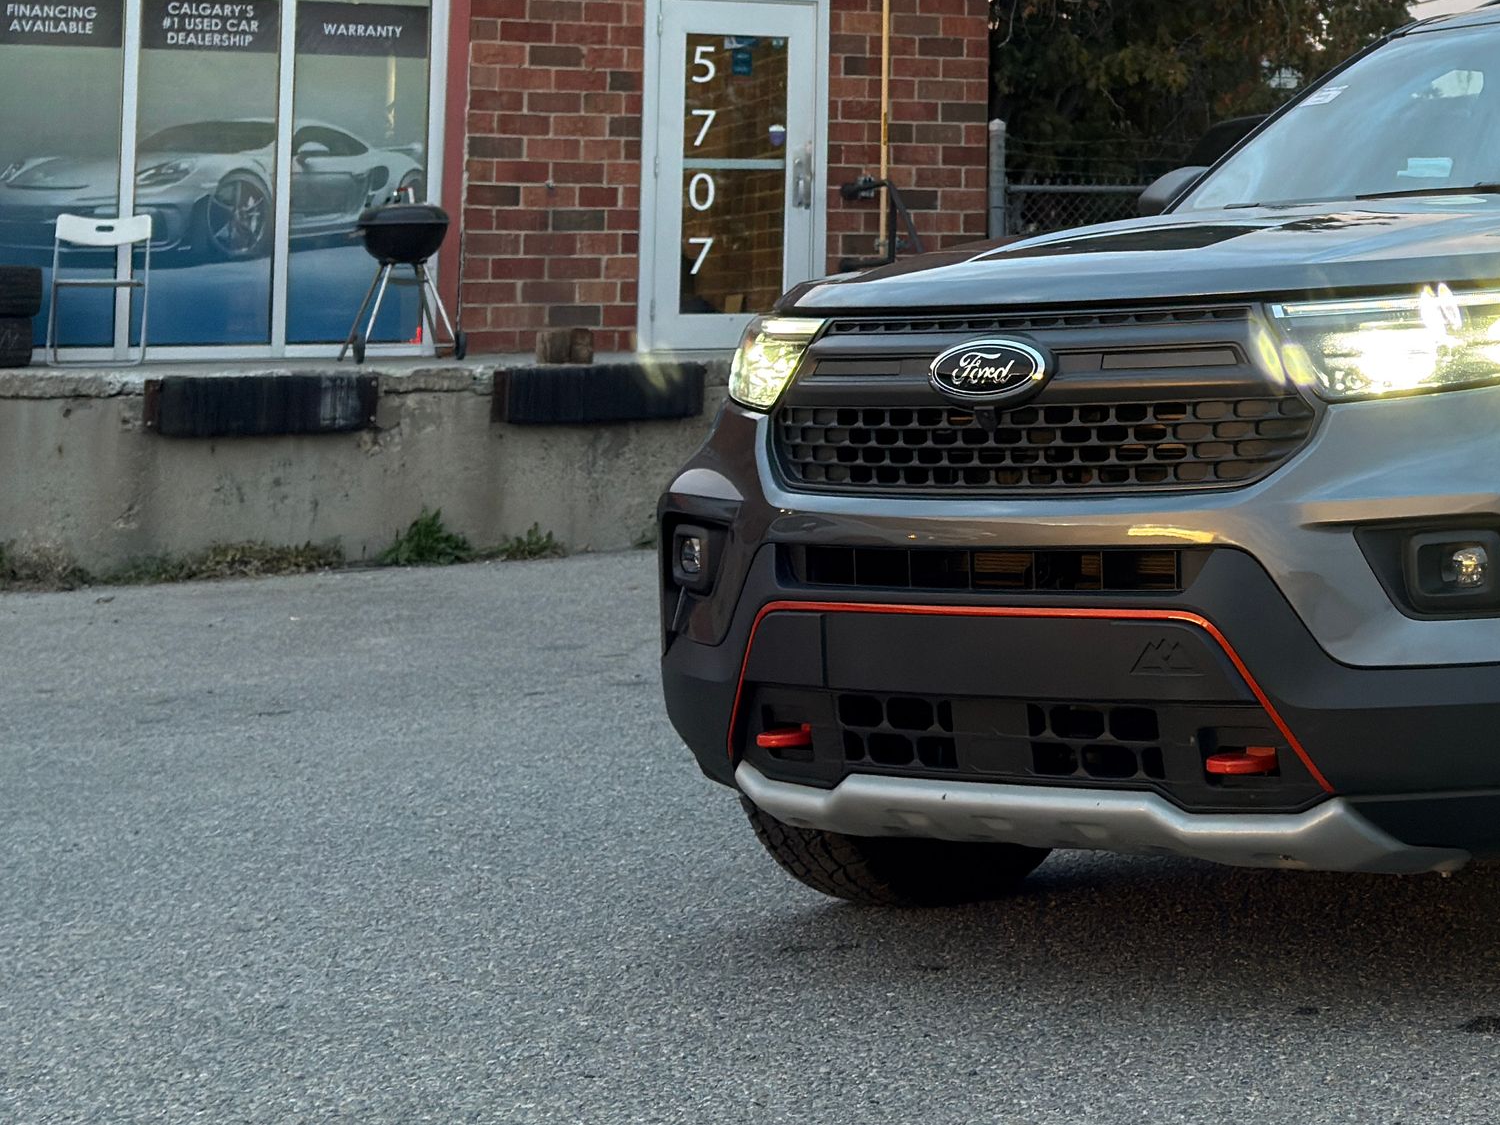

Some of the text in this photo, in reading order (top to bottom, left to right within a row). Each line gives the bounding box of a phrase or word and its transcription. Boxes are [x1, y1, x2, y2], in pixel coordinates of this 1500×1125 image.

[6, 3, 98, 19] FINANCING
[167, 1, 254, 18] CALGARY'S
[9, 19, 94, 34] AVAILABLE
[162, 17, 259, 32] #1 USED CAR
[323, 22, 403, 38] WARRANTY
[166, 32, 253, 47] DEALERSHIP
[951, 351, 1016, 384] Ford
